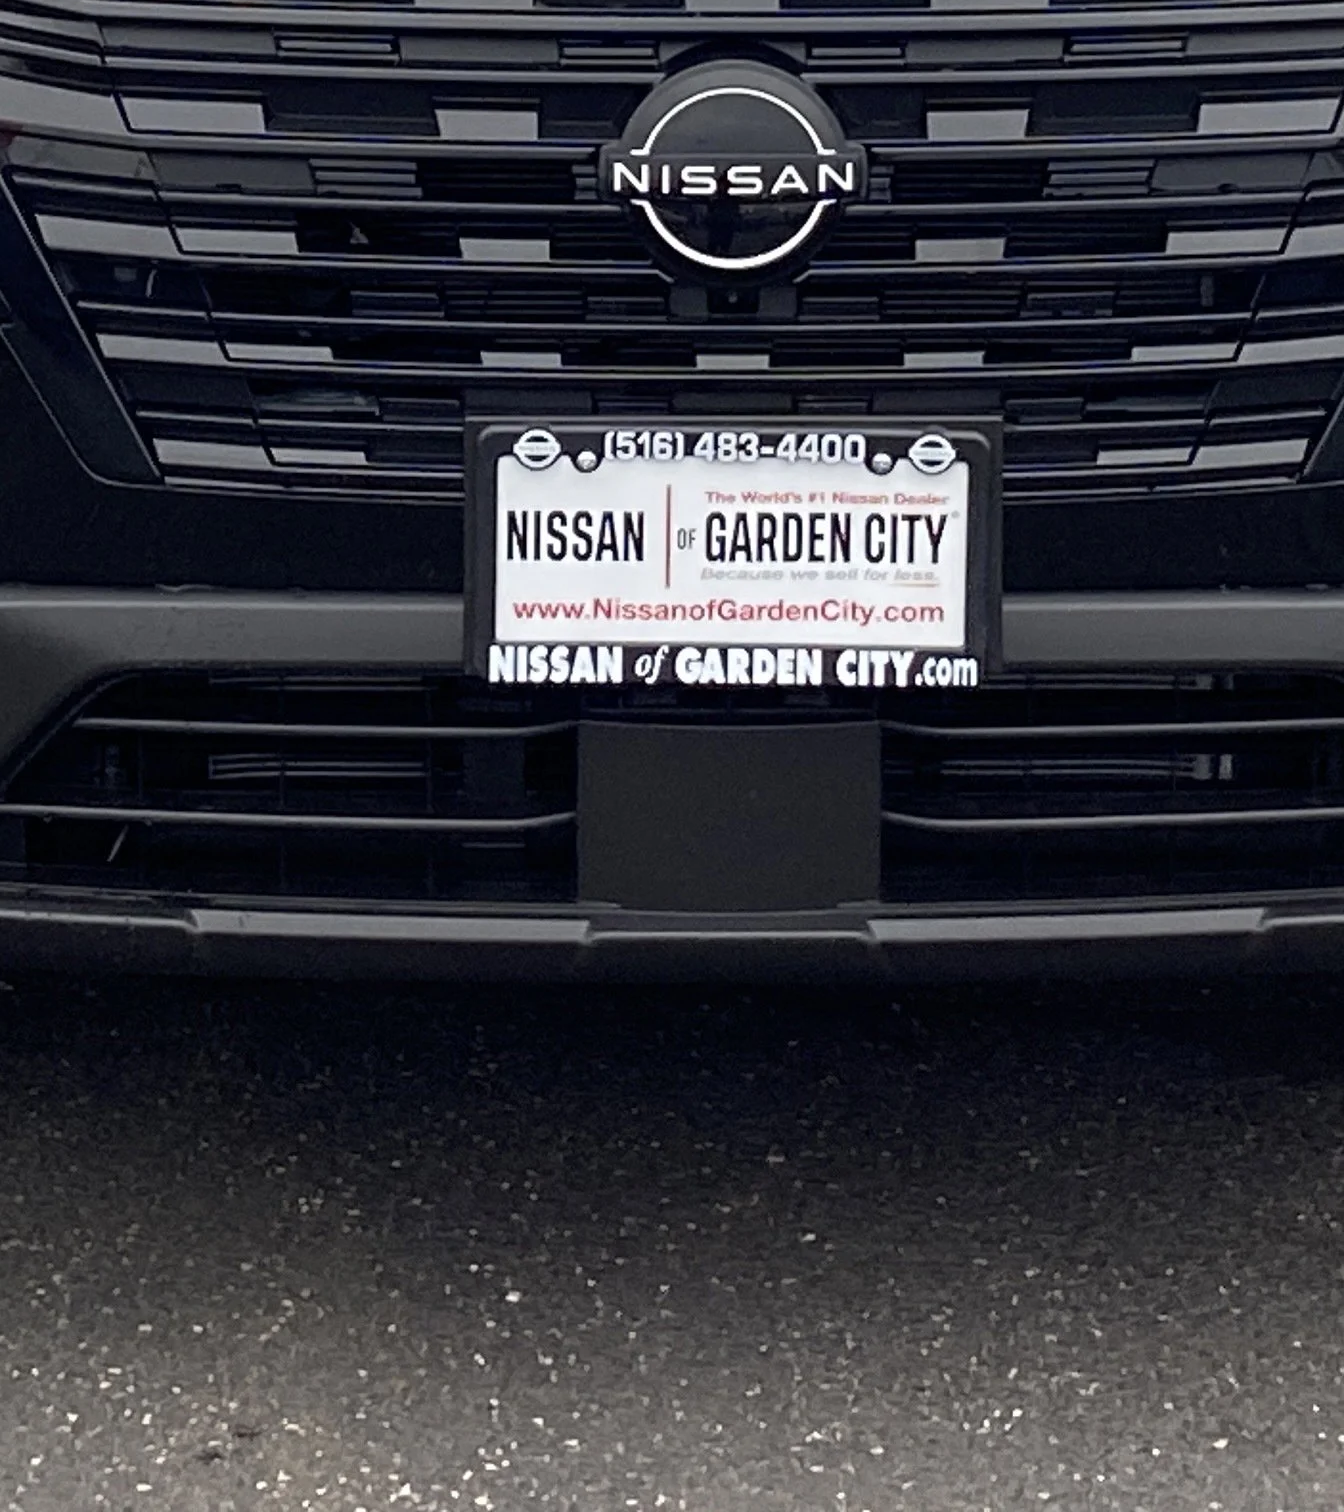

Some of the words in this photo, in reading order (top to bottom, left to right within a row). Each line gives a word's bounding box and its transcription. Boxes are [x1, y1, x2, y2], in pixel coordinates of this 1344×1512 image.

[613, 162, 853, 194] NISSAN
[604, 431, 684, 461] (516)
[694, 432, 866, 464] 483-4400
[705, 491, 736, 504] The
[741, 491, 803, 505] World's
[808, 492, 825, 505] #1
[832, 492, 889, 505] Nissan
[894, 493, 950, 506] Dealer
[506, 511, 644, 561] NISSAN
[677, 528, 696, 549] OF
[705, 512, 851, 563] GARDEN
[864, 513, 948, 564] CITY
[701, 568, 784, 581] Because
[790, 571, 818, 581] we
[825, 568, 858, 581] sell
[863, 568, 889, 581] for
[513, 598, 944, 626] www.NissanofGardenCity.com
[488, 645, 623, 684] NISSAN
[635, 646, 669, 685] of
[675, 648, 823, 686] GARDEN
[836, 650, 978, 687] CITY.com
